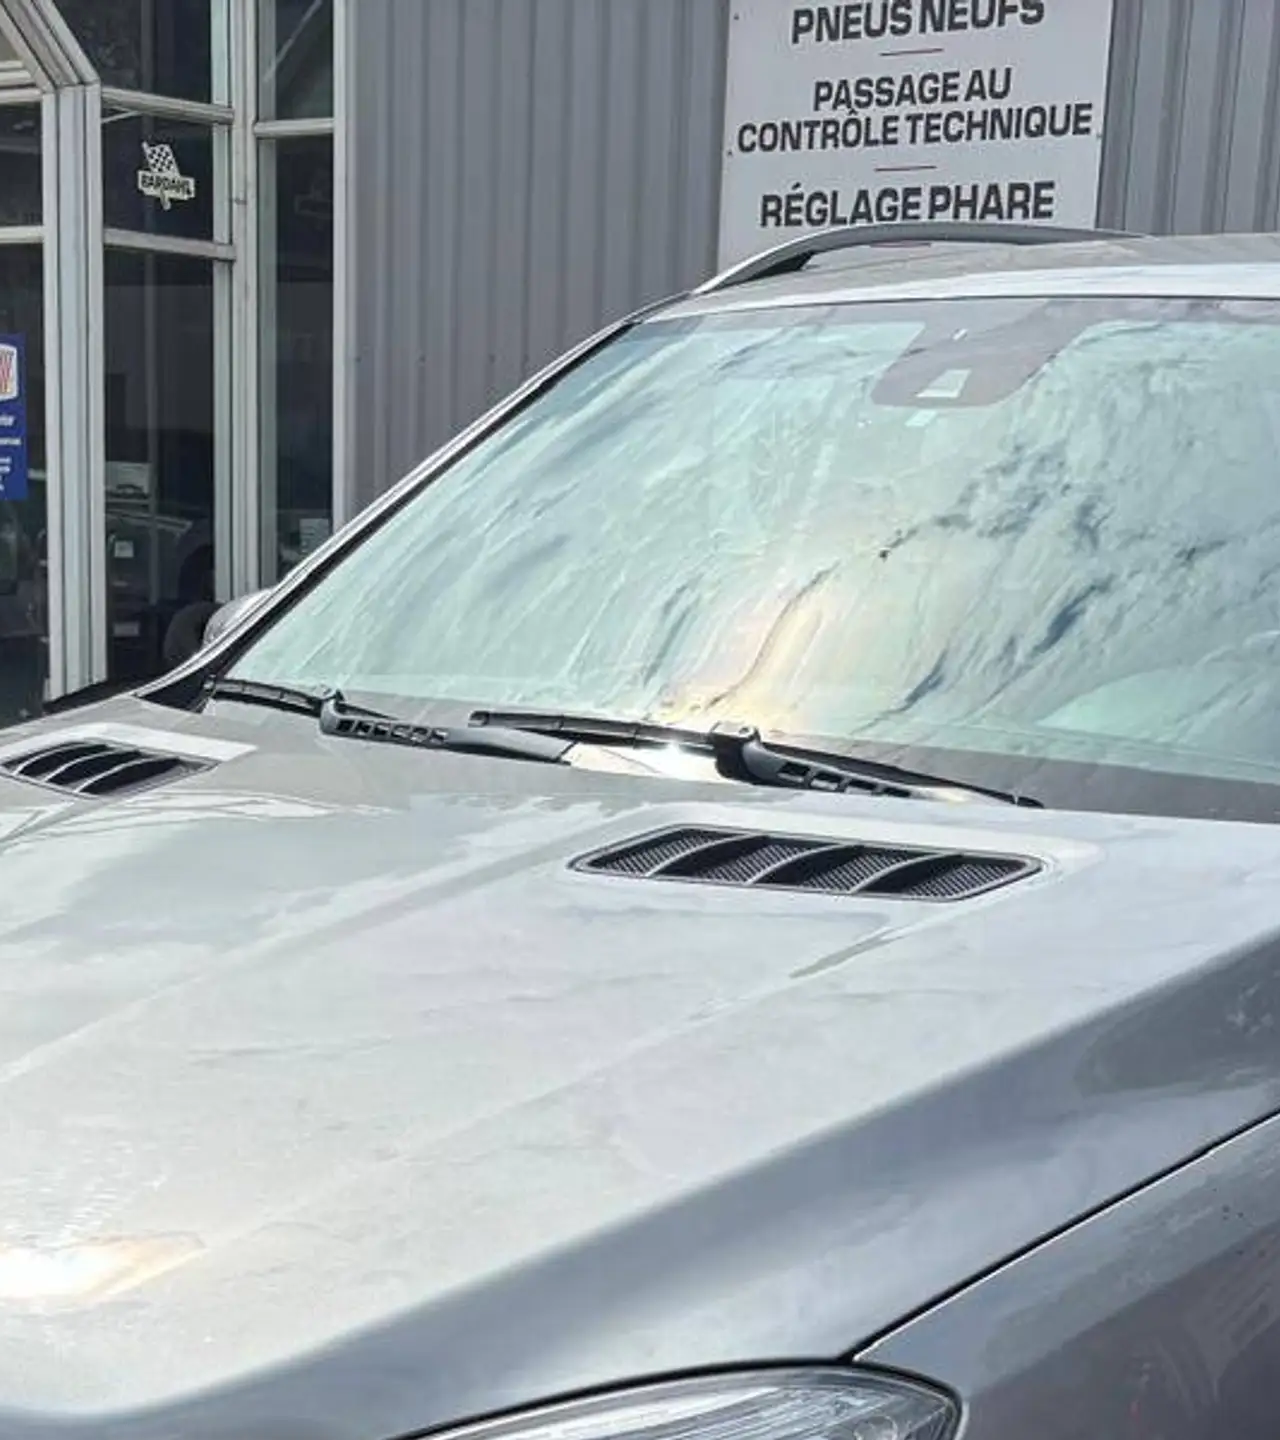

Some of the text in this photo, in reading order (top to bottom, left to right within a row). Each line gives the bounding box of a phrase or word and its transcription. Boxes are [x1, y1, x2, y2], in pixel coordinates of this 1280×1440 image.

[791, 0, 1045, 45] PNEUS NEUFS
[813, 67, 1013, 112] PASSAGE AU
[737, 102, 1093, 154] CONTRÔLE TECHNIQUE
[760, 180, 1056, 229] RÉGLAGE PHARE
